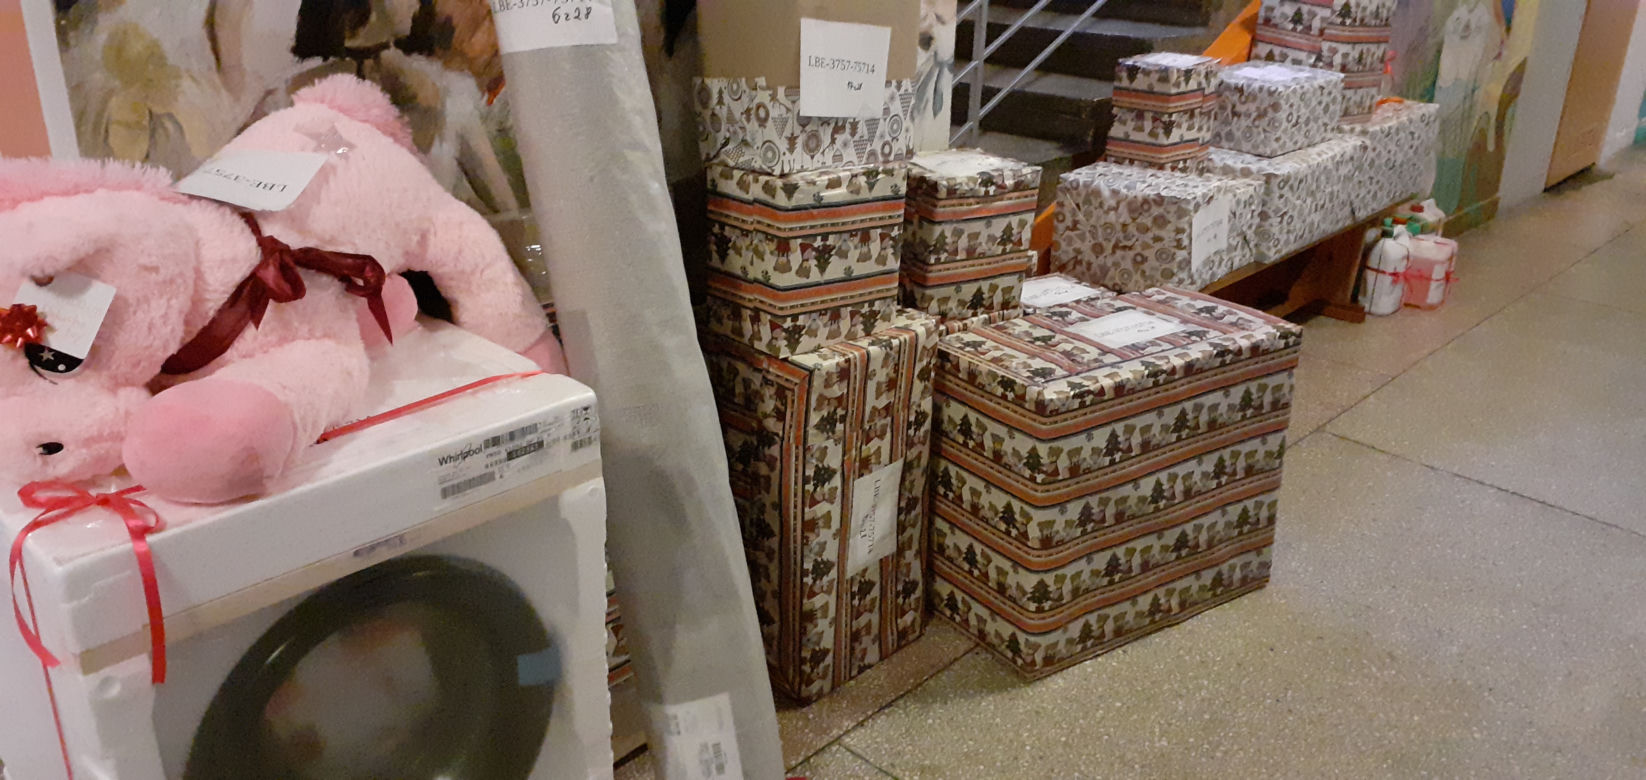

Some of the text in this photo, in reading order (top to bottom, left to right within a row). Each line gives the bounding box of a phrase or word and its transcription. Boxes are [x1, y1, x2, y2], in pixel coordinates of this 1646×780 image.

[808, 55, 875, 74] LBE-3757-75714
[203, 167, 288, 192] LBE-3757
[438, 443, 483, 467] Whirlpool
